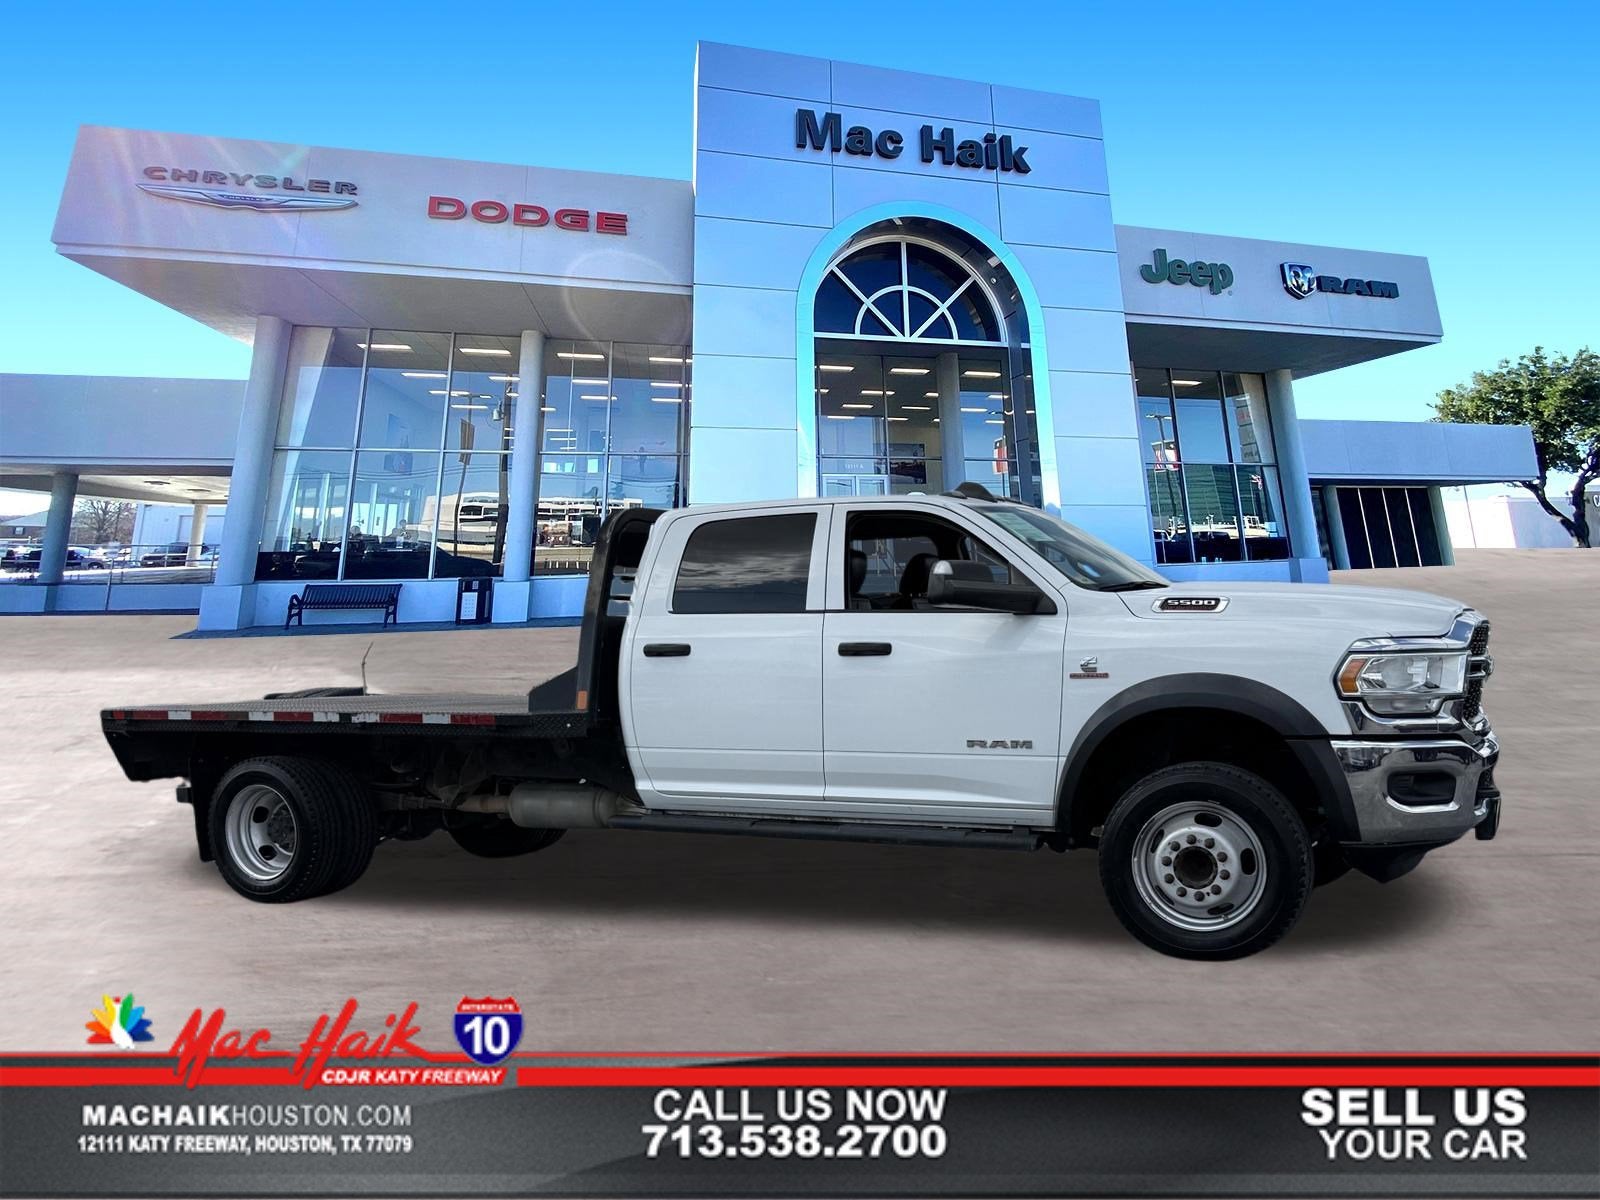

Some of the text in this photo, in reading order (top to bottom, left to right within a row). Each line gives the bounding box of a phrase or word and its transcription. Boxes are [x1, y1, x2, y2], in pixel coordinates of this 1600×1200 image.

[796, 108, 1032, 174] Mac Haik
[142, 166, 359, 196] CHRYSLER
[427, 195, 628, 236] DODGE
[1140, 248, 1234, 295] Jeep
[1316, 275, 1400, 299] RAM
[966, 739, 1033, 749] RAM
